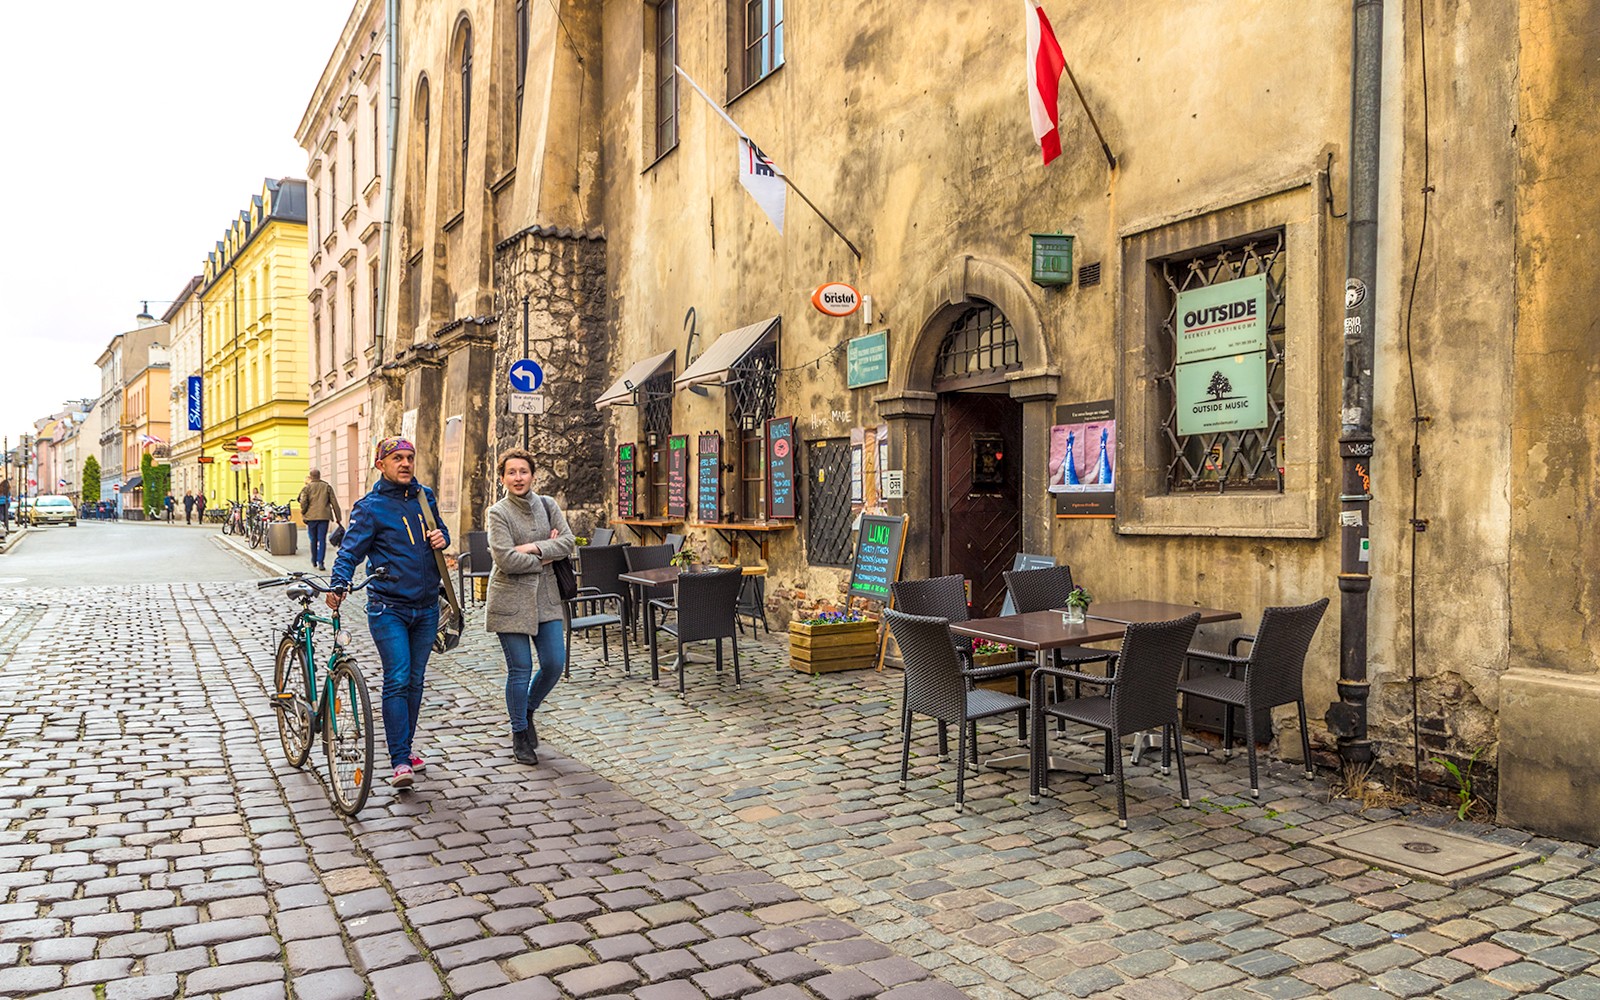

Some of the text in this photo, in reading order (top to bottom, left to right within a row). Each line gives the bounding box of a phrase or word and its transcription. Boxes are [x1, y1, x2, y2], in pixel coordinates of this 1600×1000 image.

[824, 292, 855, 304] bristot
[1184, 298, 1257, 328] OUTSIDE
[1213, 322, 1257, 335] CASTINGOWA
[189, 381, 201, 429] Shalom
[1192, 400, 1249, 414] OUTSIDE MUSIC
[868, 523, 891, 546] LUNCH
